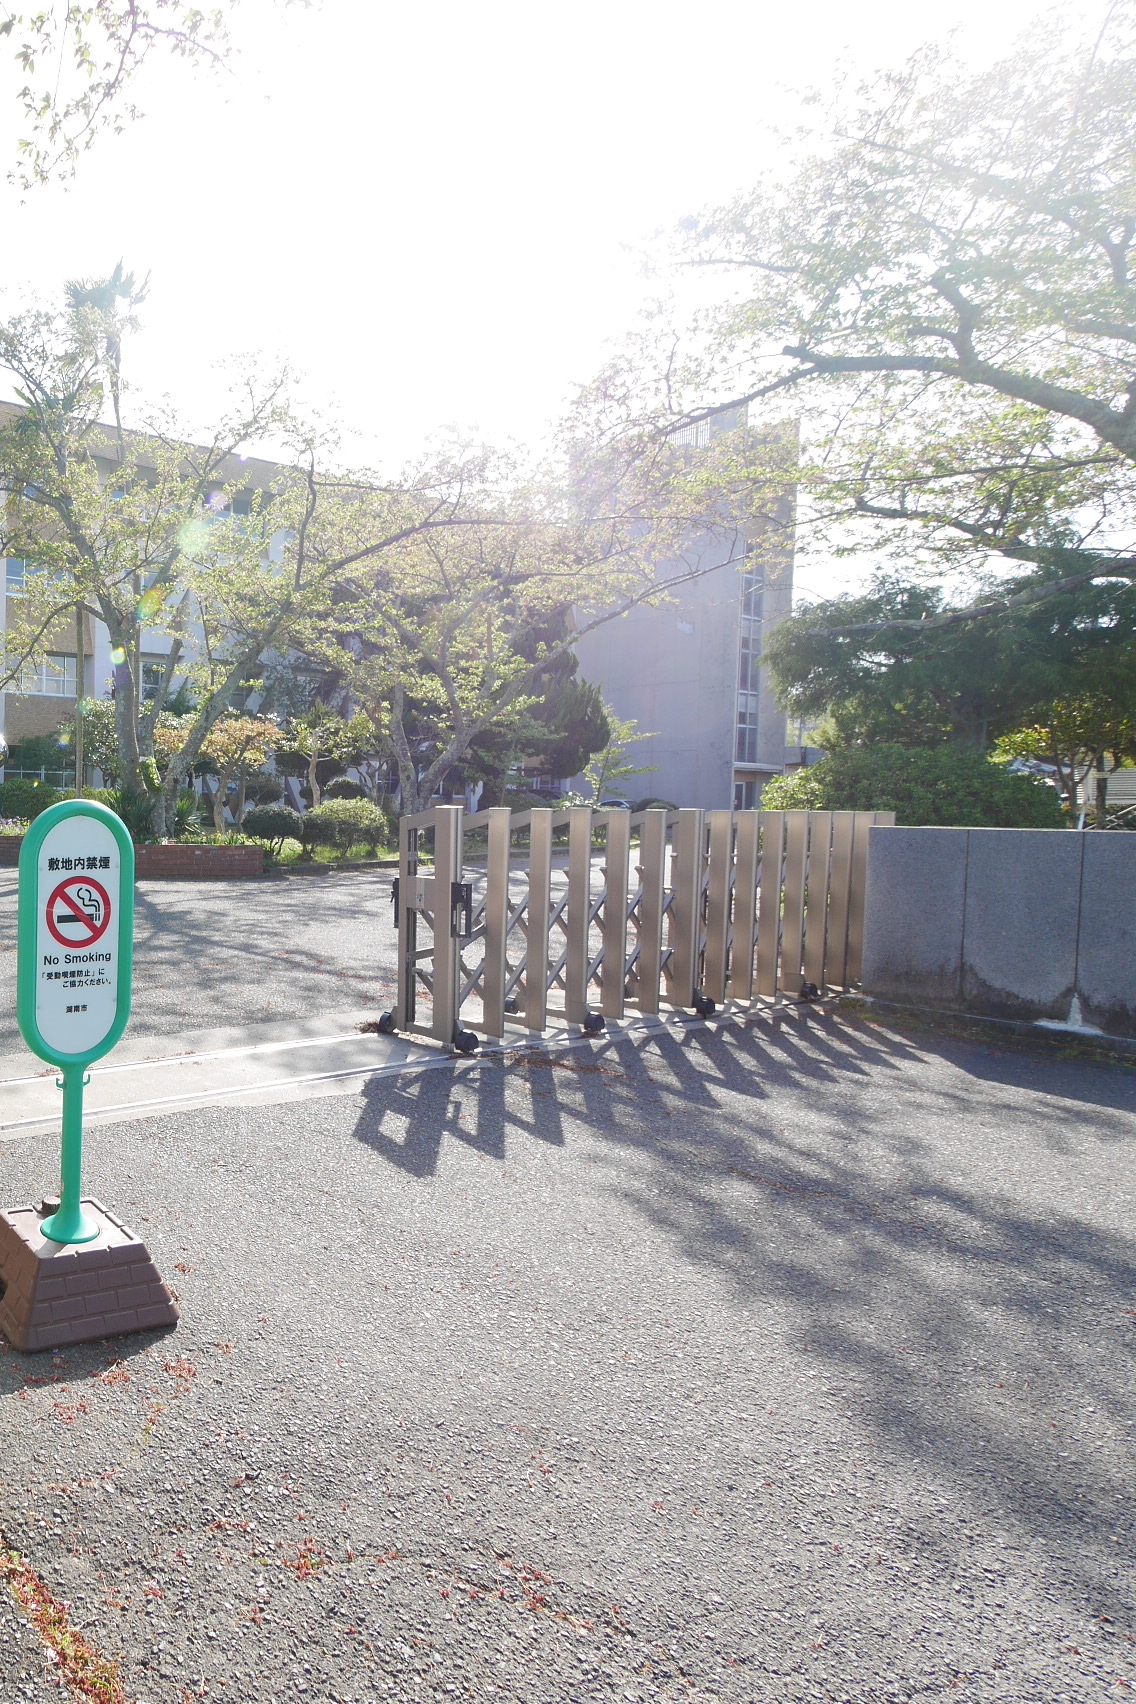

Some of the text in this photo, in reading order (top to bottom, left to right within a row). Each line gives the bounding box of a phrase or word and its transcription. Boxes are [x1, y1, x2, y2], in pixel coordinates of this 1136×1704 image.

[48, 856, 110, 871] 敷地内禁煙
[43, 952, 111, 965] No Smoking
[62, 978, 111, 988] ご協力ください。
